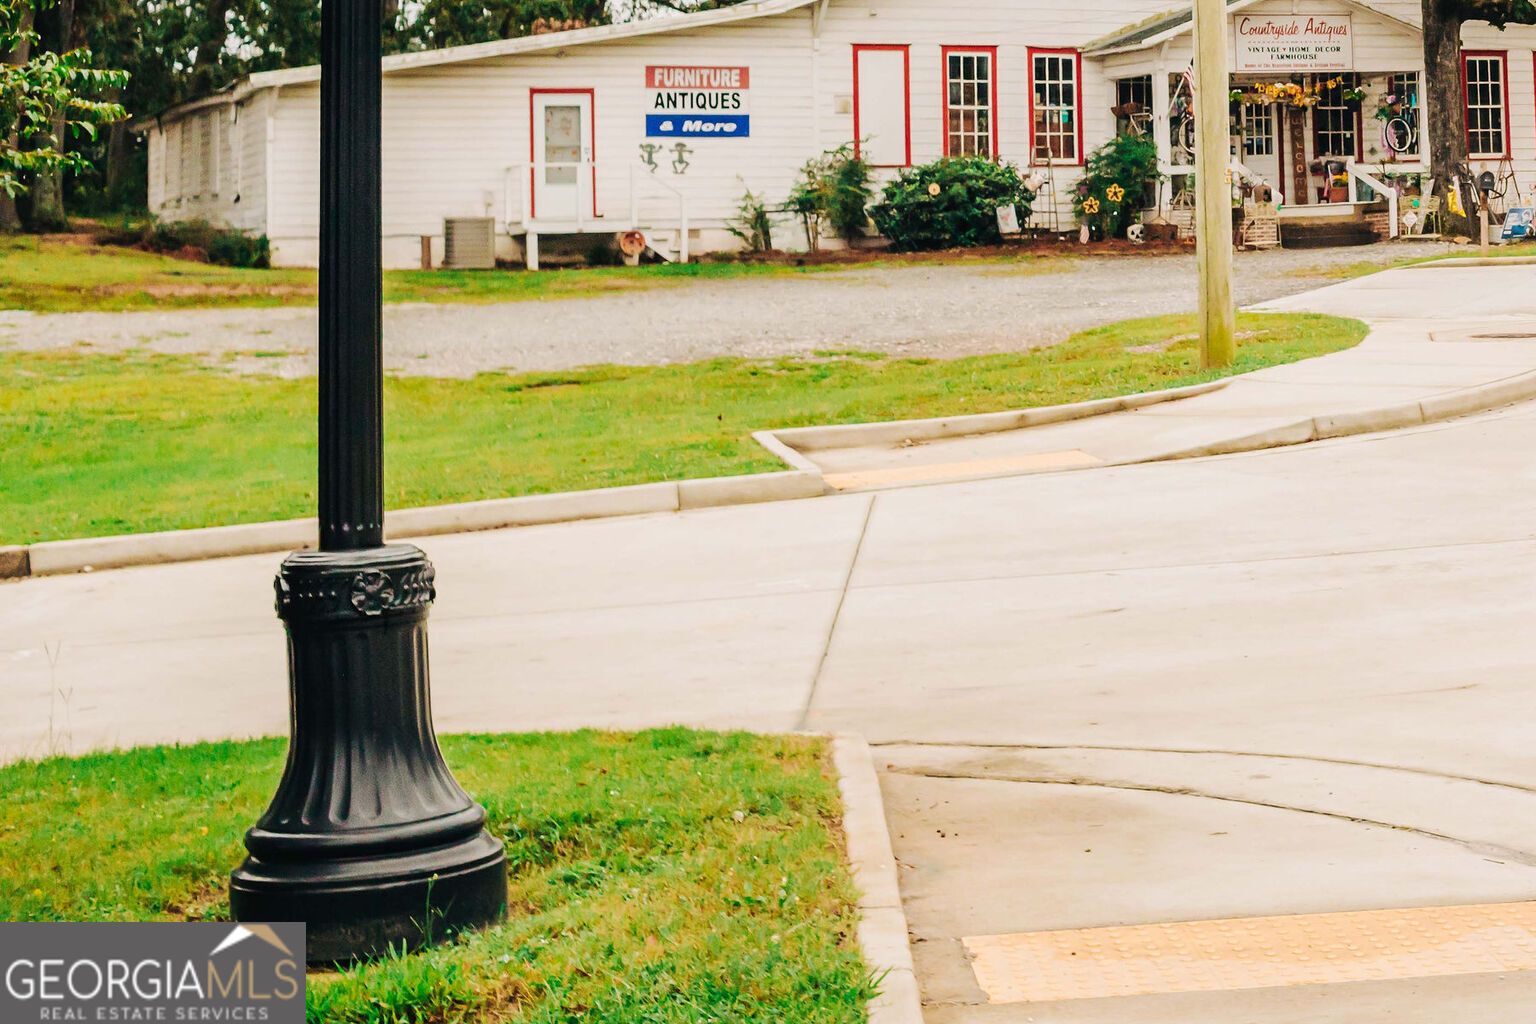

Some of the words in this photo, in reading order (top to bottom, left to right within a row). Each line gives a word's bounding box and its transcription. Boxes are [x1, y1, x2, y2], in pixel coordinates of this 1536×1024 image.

[1239, 17, 1299, 40] Countryside
[1304, 17, 1347, 41] Antiques
[654, 67, 741, 88] FURNITURE
[654, 91, 741, 110] ANTIQUES
[682, 119, 737, 132] More
